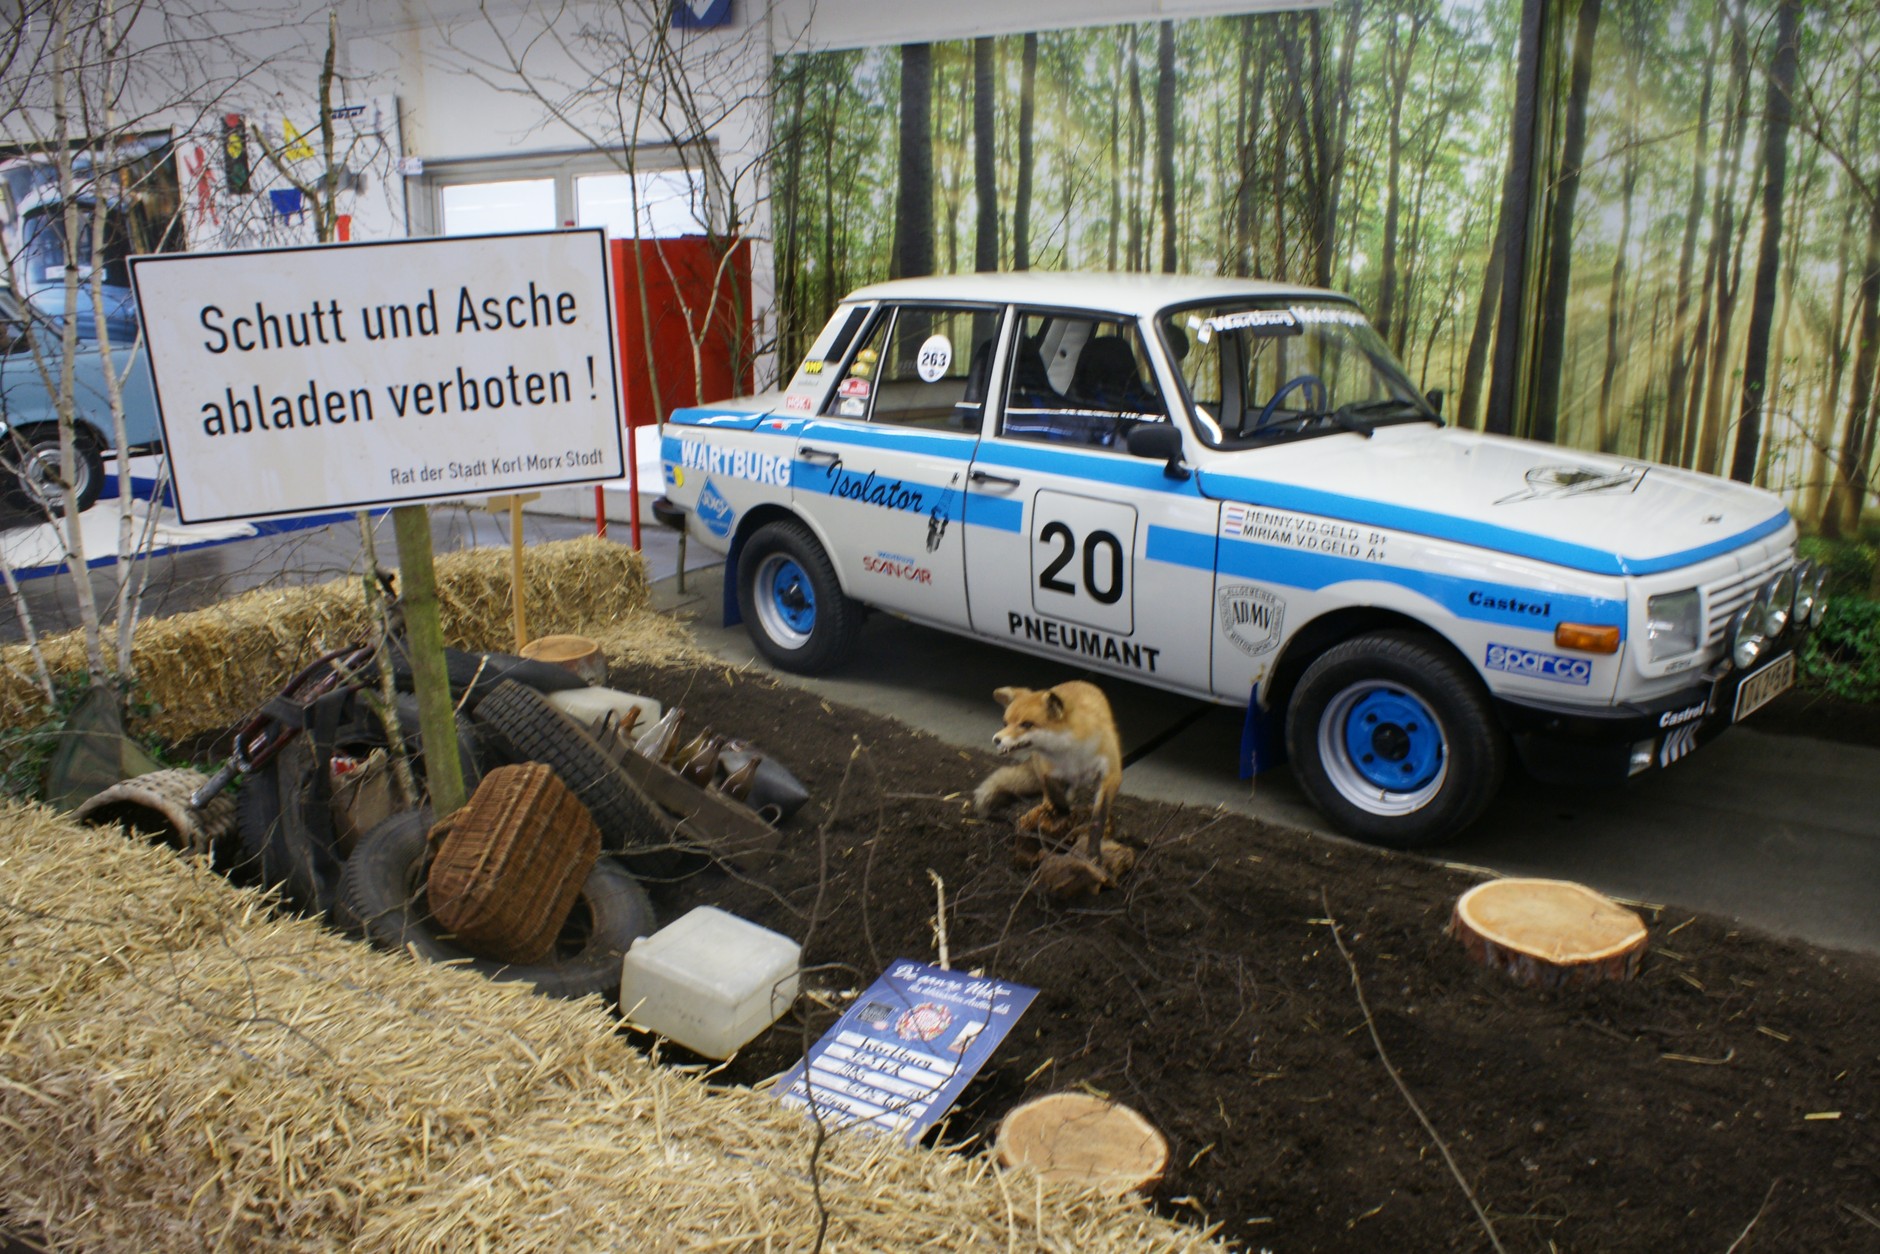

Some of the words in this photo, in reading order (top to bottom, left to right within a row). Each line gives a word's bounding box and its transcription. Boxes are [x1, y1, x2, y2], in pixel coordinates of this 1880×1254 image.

[200, 299, 347, 354] Schutt
[361, 288, 439, 341] und
[455, 281, 577, 334] Asche
[921, 352, 947, 367] 263
[200, 379, 374, 437] abladen
[387, 365, 572, 418] verboten
[586, 356, 598, 400] !
[390, 467, 416, 485] Rat
[420, 463, 445, 482] der
[449, 460, 488, 480] Stadt
[681, 439, 791, 487] WARTBURG
[826, 459, 924, 513] Isolator
[1039, 520, 1124, 605] 20
[1232, 601, 1273, 630] ADMV
[1468, 591, 1551, 618] Castrol
[1008, 611, 1160, 673] PNEUMANT
[1488, 645, 1589, 680] sparco
[1659, 699, 1708, 729] Castrol
